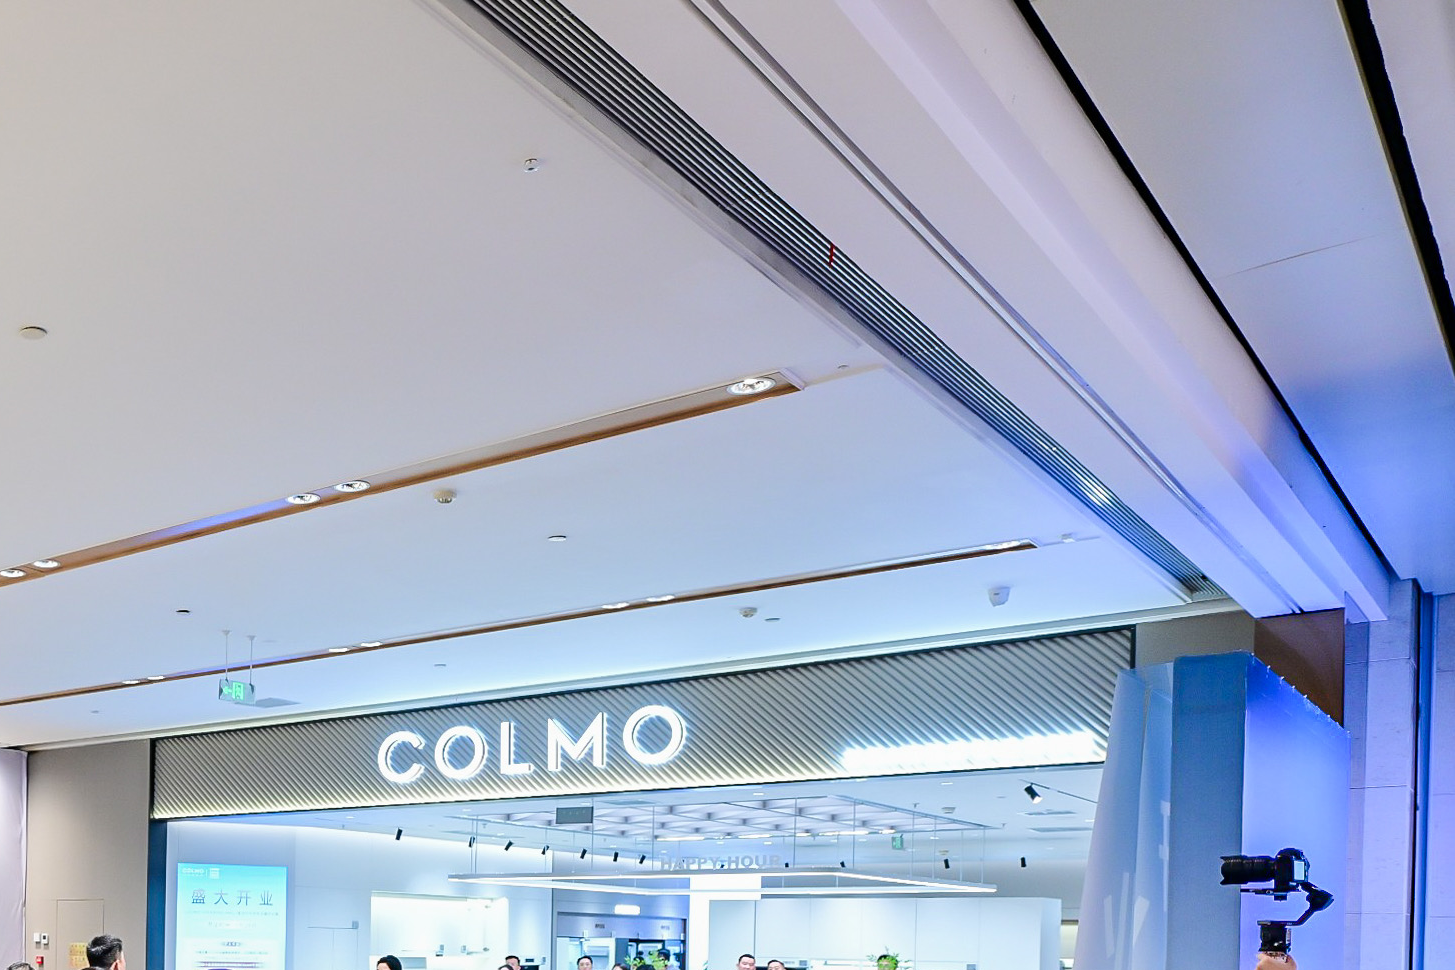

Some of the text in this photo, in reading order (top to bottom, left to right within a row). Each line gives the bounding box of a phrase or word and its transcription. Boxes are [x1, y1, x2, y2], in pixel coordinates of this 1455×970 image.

[377, 704, 687, 784] COLMO
[660, 854, 782, 870] HAPPY HOUR
[191, 888, 274, 907] 盛大开业
